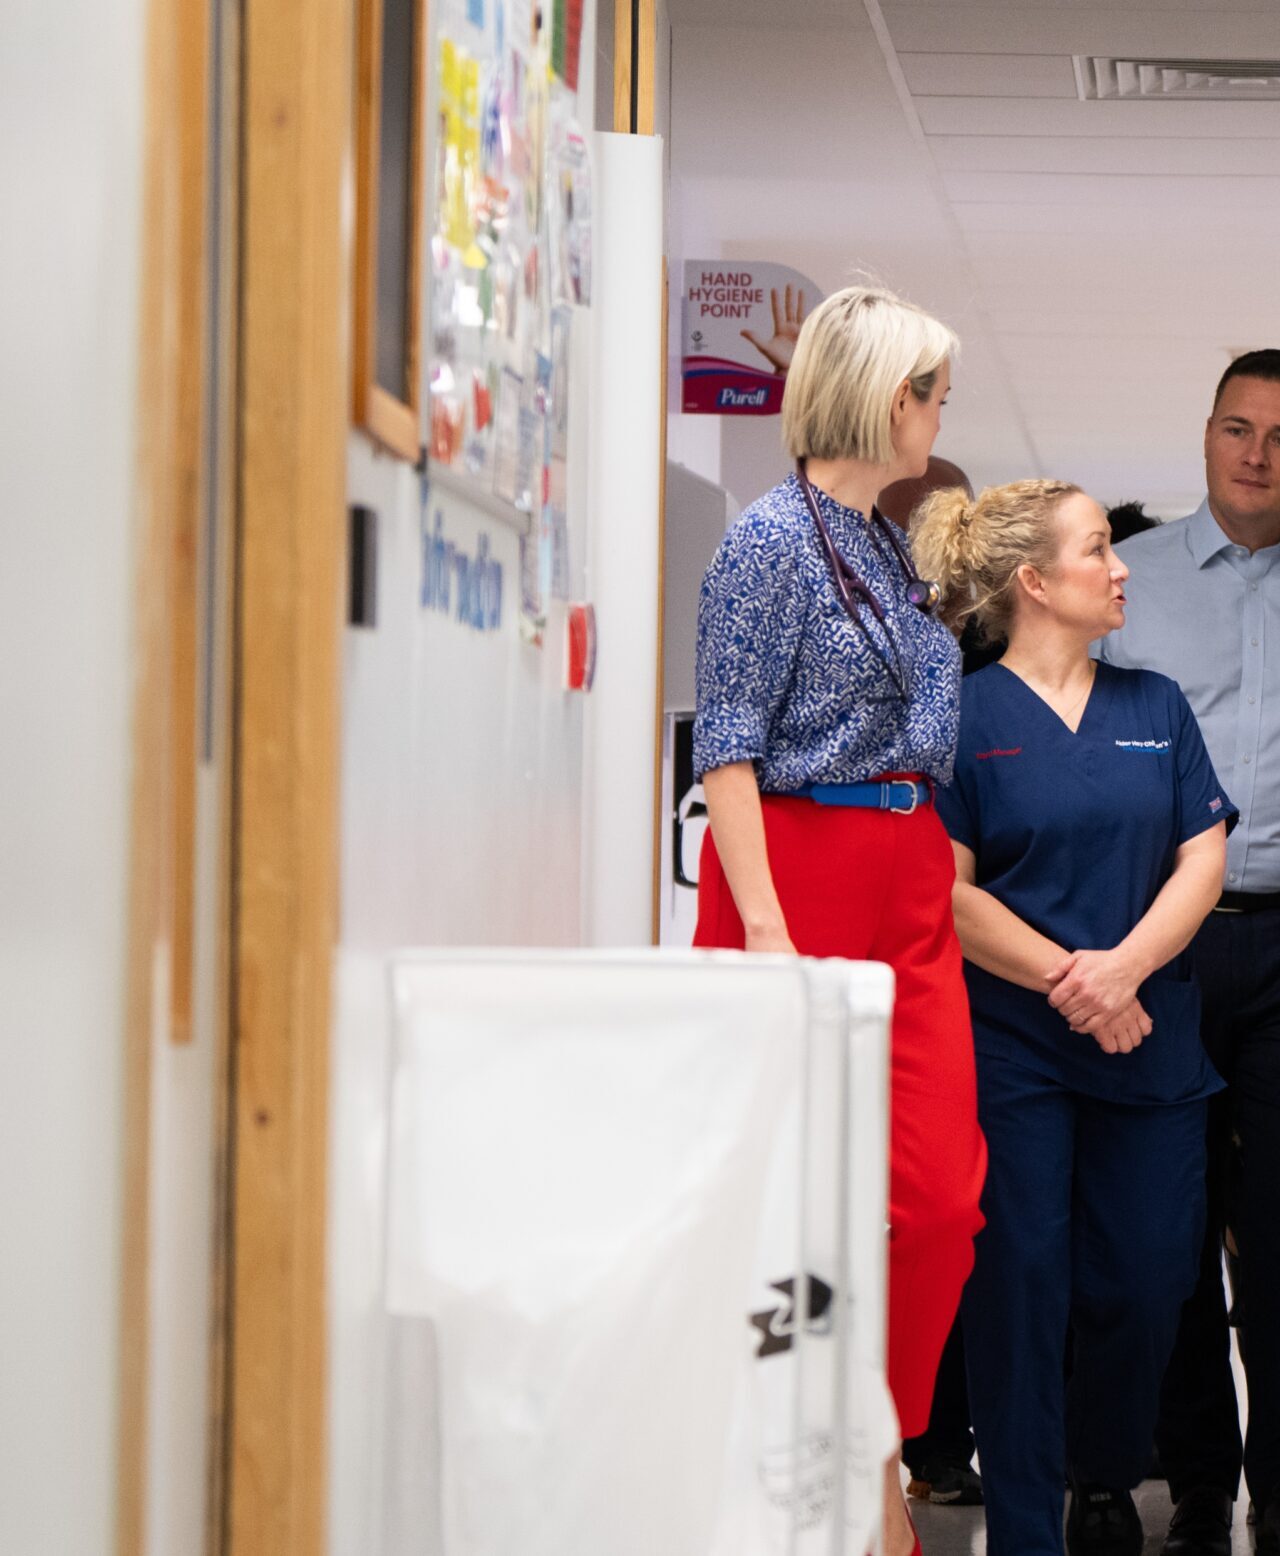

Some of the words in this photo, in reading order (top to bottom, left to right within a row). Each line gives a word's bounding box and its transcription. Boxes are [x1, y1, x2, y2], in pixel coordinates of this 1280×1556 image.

[701, 272, 752, 286] HAND
[689, 288, 763, 303] HYGIENE
[700, 304, 751, 318] POINT
[721, 388, 767, 405] Purell
